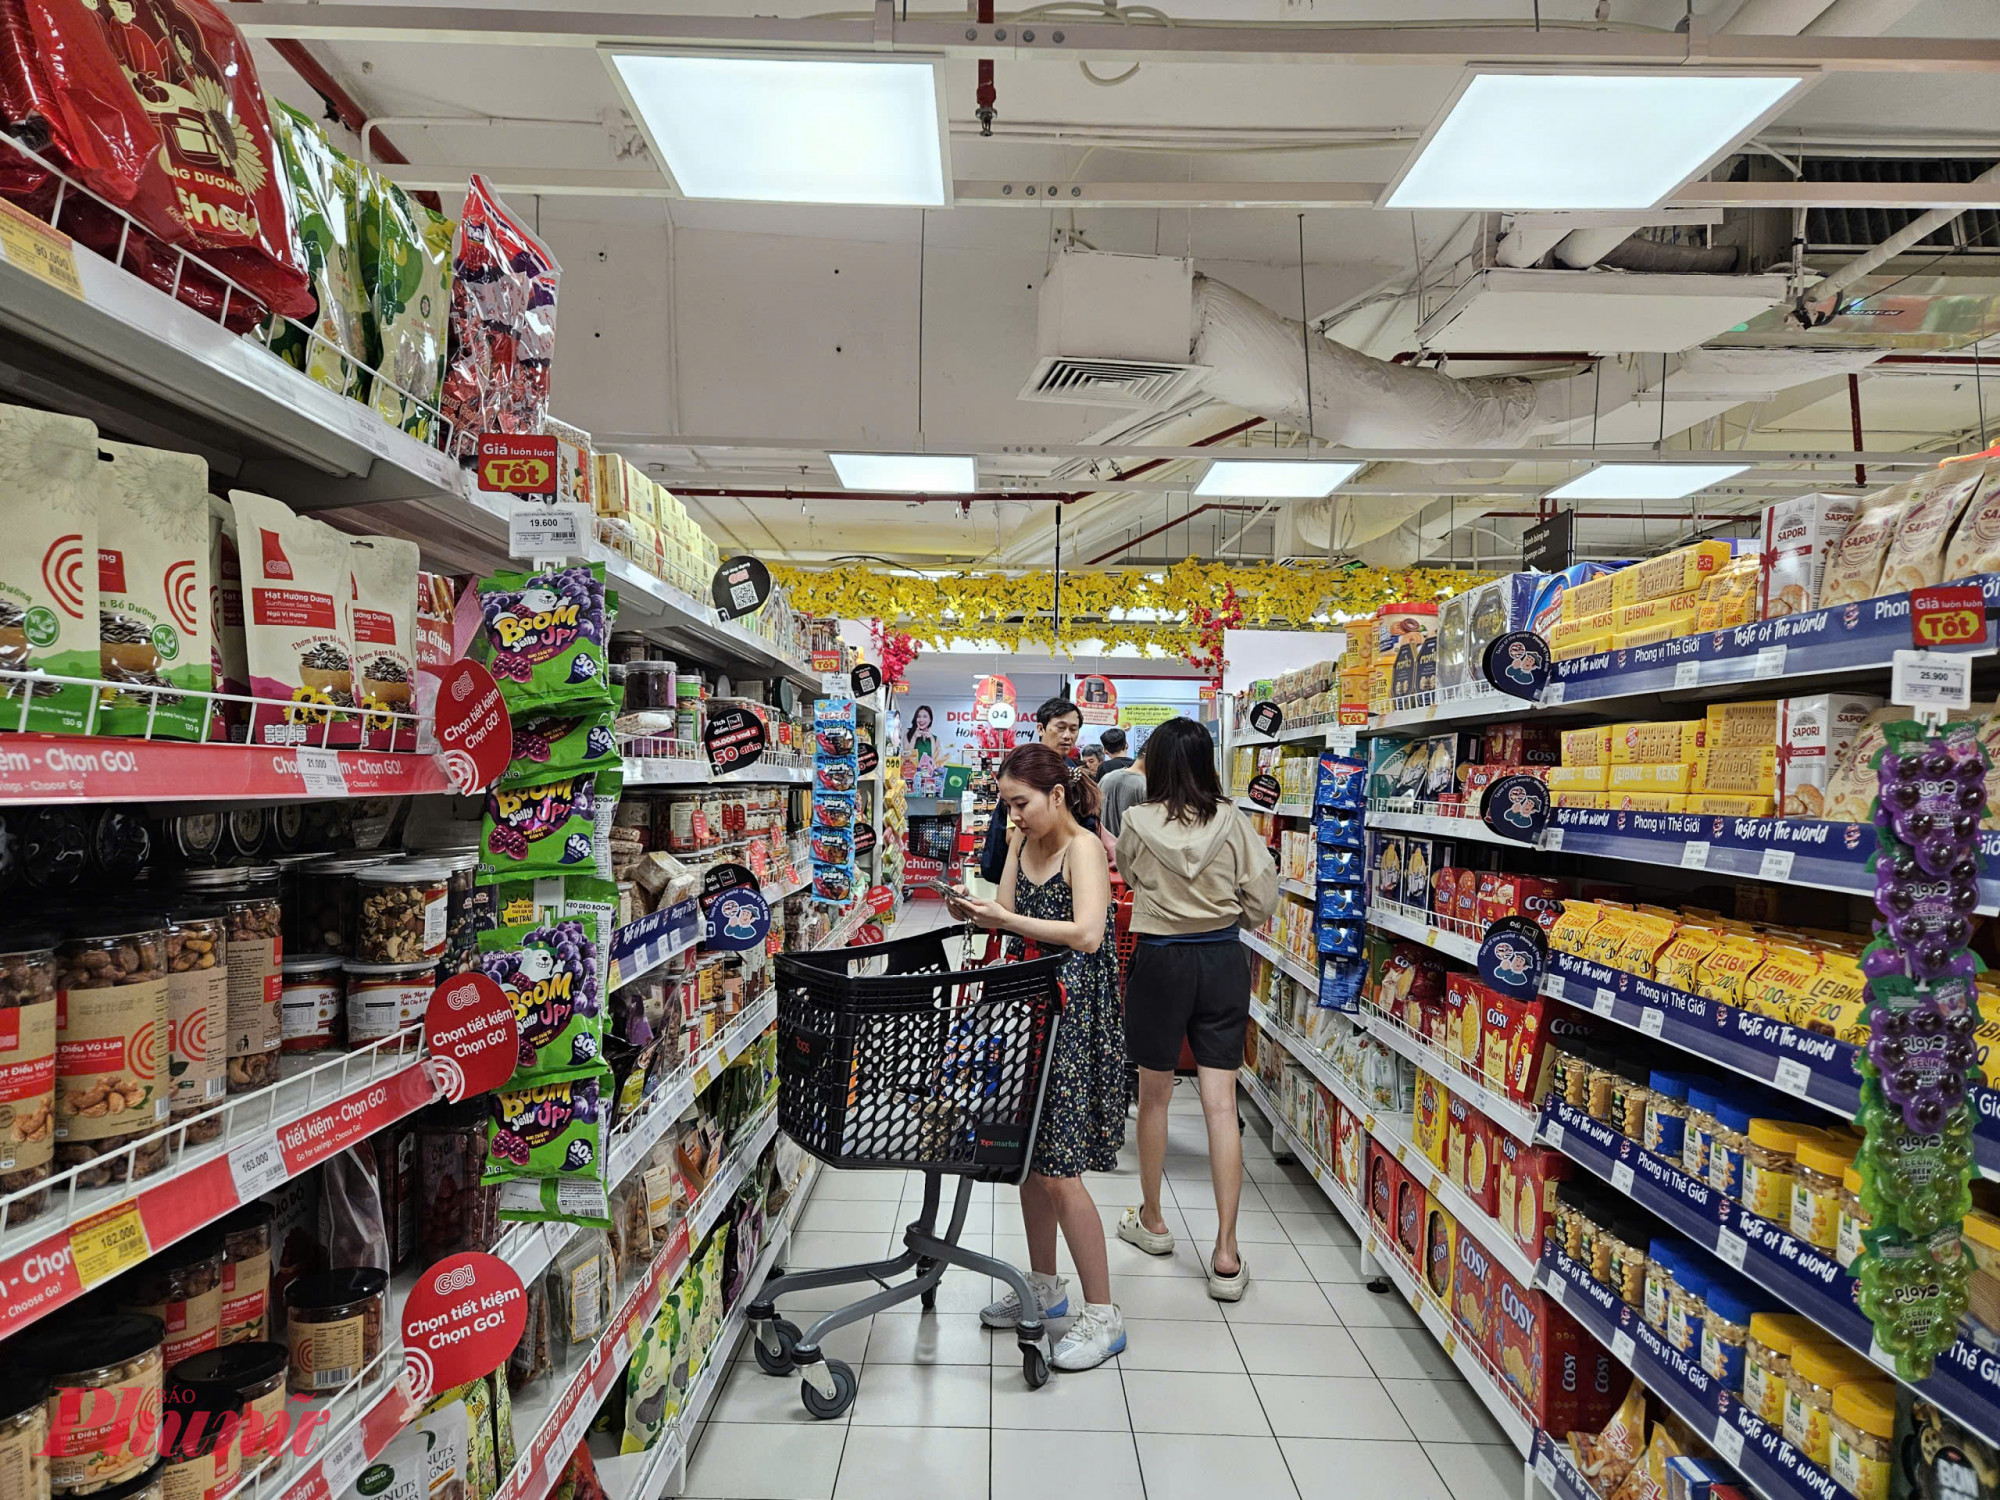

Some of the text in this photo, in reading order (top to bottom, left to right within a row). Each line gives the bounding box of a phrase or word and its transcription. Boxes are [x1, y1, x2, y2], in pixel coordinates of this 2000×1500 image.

[482, 442, 555, 457] Giá luôn luôn
[490, 459, 540, 485] Tốt
[529, 518, 558, 527] 19.600
[1777, 526, 1807, 542] SAPORI
[1844, 531, 1880, 549] SAPORI
[265, 590, 282, 602] Hạt
[1915, 597, 1984, 610] Giá luôn luôn
[1623, 593, 1696, 626] LEIBNIZ KEKS
[1555, 621, 1581, 640] LEIBNIZ
[1592, 613, 1613, 630] KEKS
[1733, 623, 1758, 647] Taste
[1758, 626, 1772, 642] of
[1791, 612, 1829, 636] world
[1924, 612, 1971, 637] Tốt
[1920, 671, 1949, 681] 25.900
[443, 687, 501, 742] Chọn tiết kiệm
[713, 718, 727, 729] Tích
[991, 710, 1008, 719] 04
[1344, 714, 1362, 724] Tốt
[464, 712, 501, 750] Chọn GO!
[711, 731, 752, 749] 10.000 vnd
[713, 726, 730, 736] điểm
[1731, 721, 1772, 738] LEIBNIZ
[1792, 726, 1820, 738] SAPORI
[712, 741, 763, 765] 50 điểm
[1637, 743, 1671, 759] LEIBNIZ
[45, 748, 100, 778] Chọn
[101, 750, 139, 773] GO!
[306, 758, 327, 769] 21.000
[357, 759, 404, 780] Chọn GO!
[1613, 767, 1679, 785] LEIBNIZ KEKS
[1634, 815, 1700, 834] Phong vị Thế Giới
[820, 835, 843, 845] park
[477, 863, 488, 871] 91
[821, 870, 844, 880] park
[905, 858, 943, 871] chúng
[592, 903, 612, 912] BOOM
[1509, 920, 1522, 929] Đổi
[1624, 945, 1642, 962] ZOO
[1755, 963, 1811, 990] LEIBNIZ
[446, 982, 481, 1011] GO!
[1636, 981, 1707, 1017] Phong vị Thế Giới
[1757, 984, 1784, 1004] ZOO
[1486, 1007, 1510, 1029] COSY
[1810, 1001, 1842, 1021] ZOO
[432, 1007, 513, 1049] Chọn tiết kiệm
[454, 1027, 509, 1060] Chọn GO!
[574, 1034, 599, 1058] 30%
[285, 1086, 388, 1150] tiết kiệm Chọn GO!
[1451, 1099, 1467, 1122] COSY
[296, 1123, 362, 1162] Go for savings Choose Go!
[570, 1139, 595, 1165] 30%
[1502, 1136, 1518, 1162] COSY
[1895, 1134, 1929, 1153] play
[242, 1152, 269, 1172] 163.000
[1637, 1151, 1710, 1206] Phong vị Thế Giới
[100, 1224, 137, 1249] 182.000
[1739, 1211, 1767, 1240] Taste
[1763, 1230, 1780, 1250] of
[1797, 1251, 1839, 1284] world
[1460, 1236, 1490, 1283] COSY
[434, 1264, 476, 1295] GO!
[8, 1281, 62, 1318] Choose Go!
[1894, 1284, 1928, 1304] play
[407, 1287, 520, 1338] Chọn tiết kiệm
[1501, 1282, 1537, 1337] COSY
[428, 1310, 506, 1351] Chọn GO!
[1636, 1320, 1709, 1393] Phong vị Thế Giới
[1562, 1351, 1576, 1392] COSY
[535, 1408, 559, 1456] Hương
[565, 1385, 580, 1412] bạn
[574, 1368, 588, 1395] yêu
[1553, 1446, 1567, 1472] Taste
[1565, 1466, 1575, 1483] of
[1737, 1406, 1766, 1440] Taste
[1762, 1432, 1778, 1455] of
[1796, 1462, 1838, 1500] world
